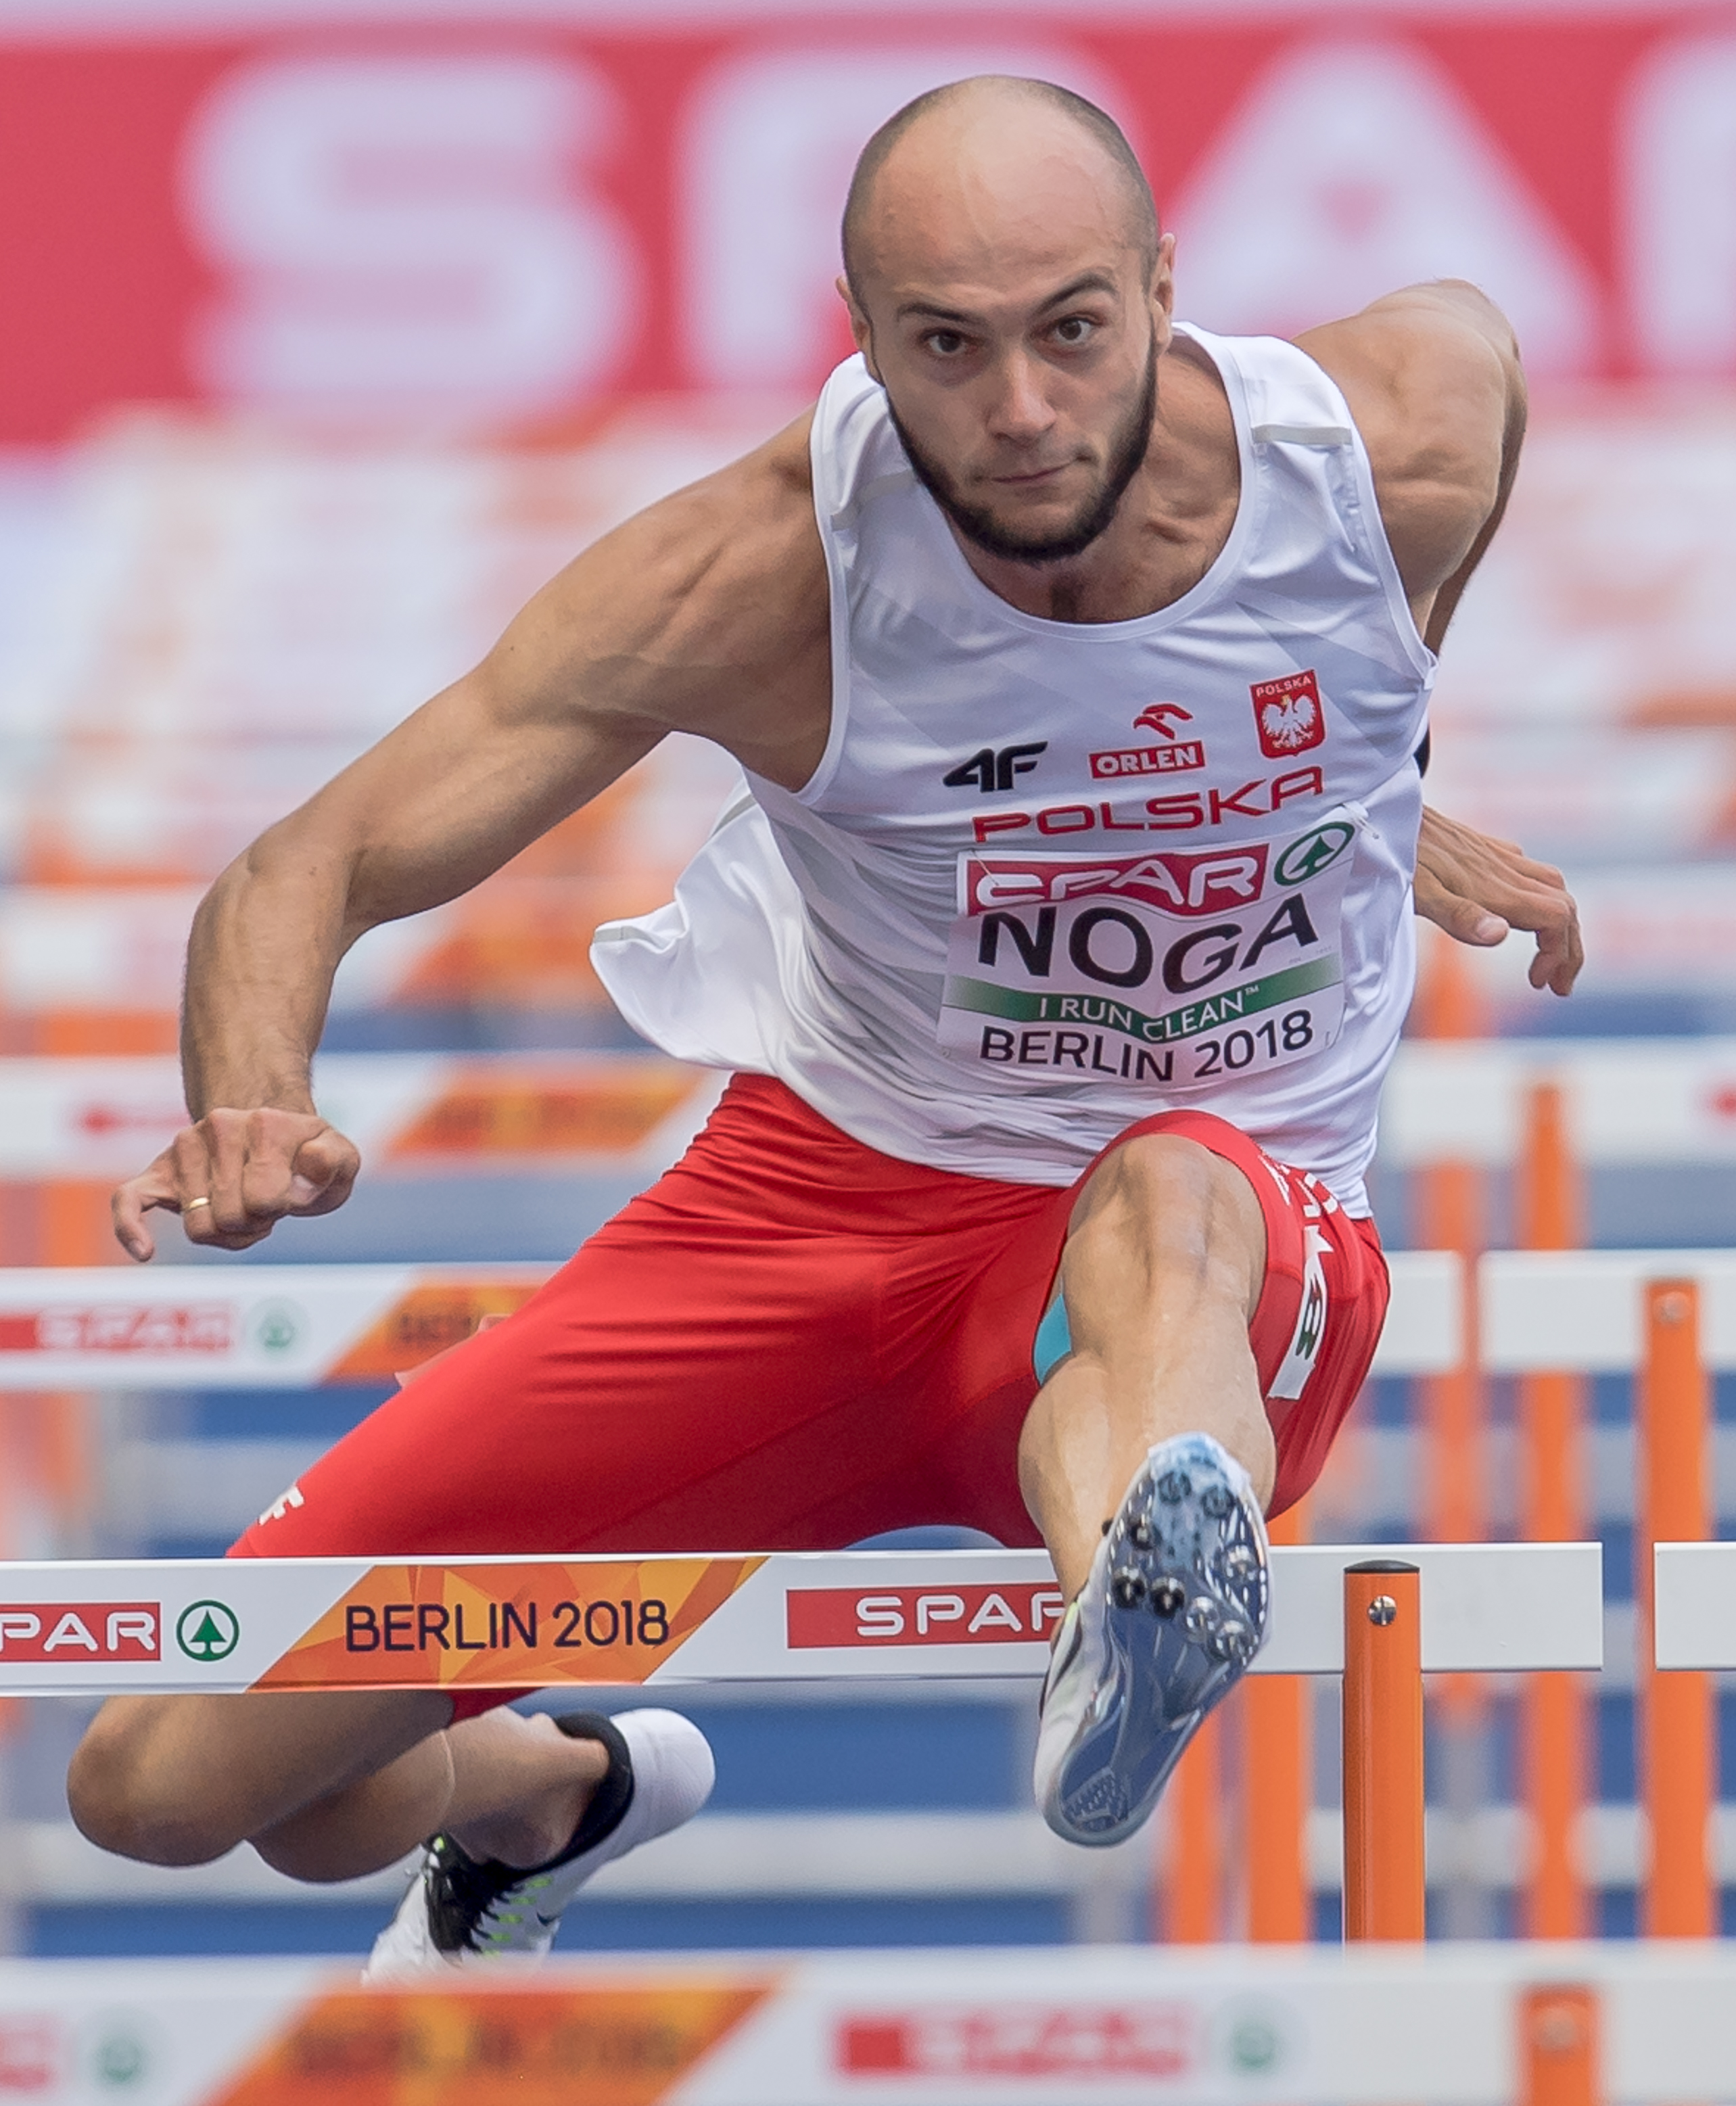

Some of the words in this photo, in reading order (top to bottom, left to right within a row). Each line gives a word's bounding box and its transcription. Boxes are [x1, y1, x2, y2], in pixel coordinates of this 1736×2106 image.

[179, 37, 1736, 413] SPA
[1256, 675, 1312, 697] POLSKA
[943, 742, 1048, 793] 4F
[1096, 746, 1198, 776] ORLEN
[972, 766, 1323, 843] POLSKA
[978, 893, 1319, 995] NOGA
[1039, 997, 1048, 1018] I
[1060, 997, 1132, 1031] RUN
[980, 1025, 1174, 1081] BERLIN
[1194, 1008, 1313, 1078] 2018
[0, 1612, 156, 1652] PAR
[345, 1601, 538, 1652] BERLIN
[552, 1599, 670, 1649] 2018
